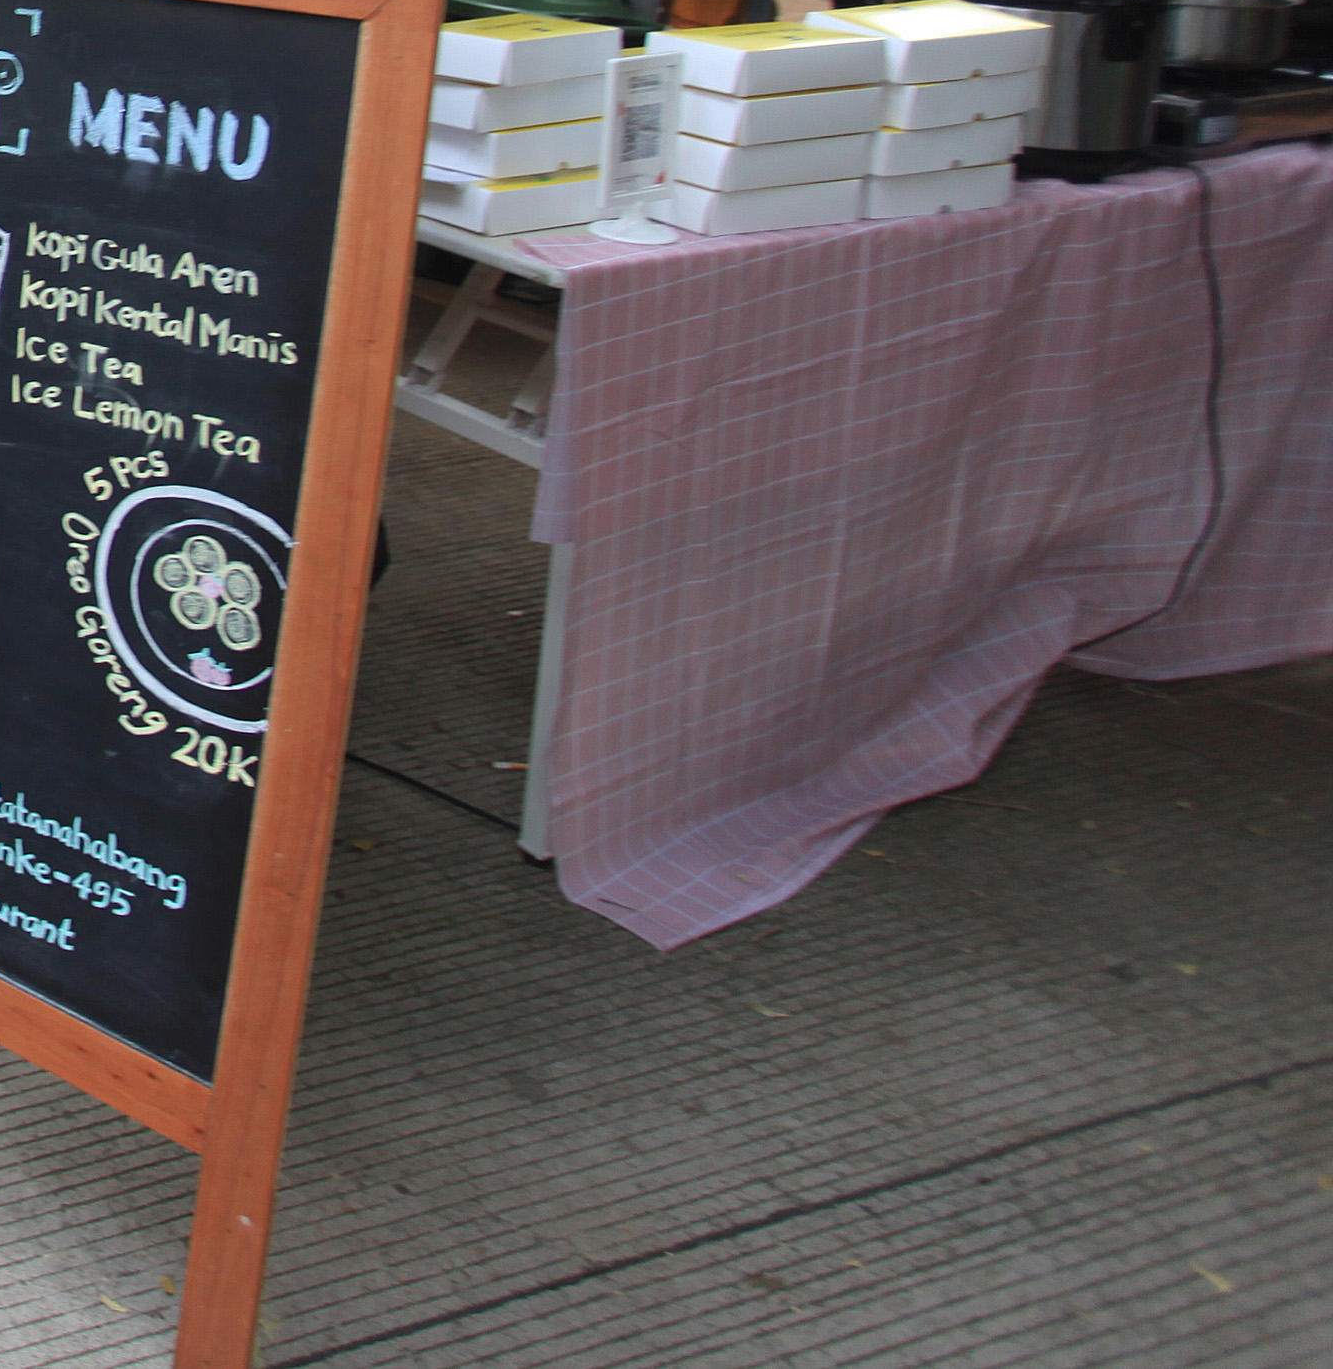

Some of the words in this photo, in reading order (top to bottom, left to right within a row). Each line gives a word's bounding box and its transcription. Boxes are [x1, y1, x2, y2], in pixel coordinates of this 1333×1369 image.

[69, 82, 269, 180] MENU
[92, 239, 164, 278] Gula
[171, 254, 258, 296] Aren
[17, 328, 68, 363] Ice
[79, 342, 143, 385] Tea
[199, 313, 298, 365] Manis
[12, 375, 61, 407] Ice
[73, 386, 183, 440] Lemon
[192, 414, 260, 463] Tea
[84, 467, 112, 500] 5
[62, 513, 99, 593] Oreo
[75, 606, 169, 735] Goreng
[171, 728, 258, 786] 20K
